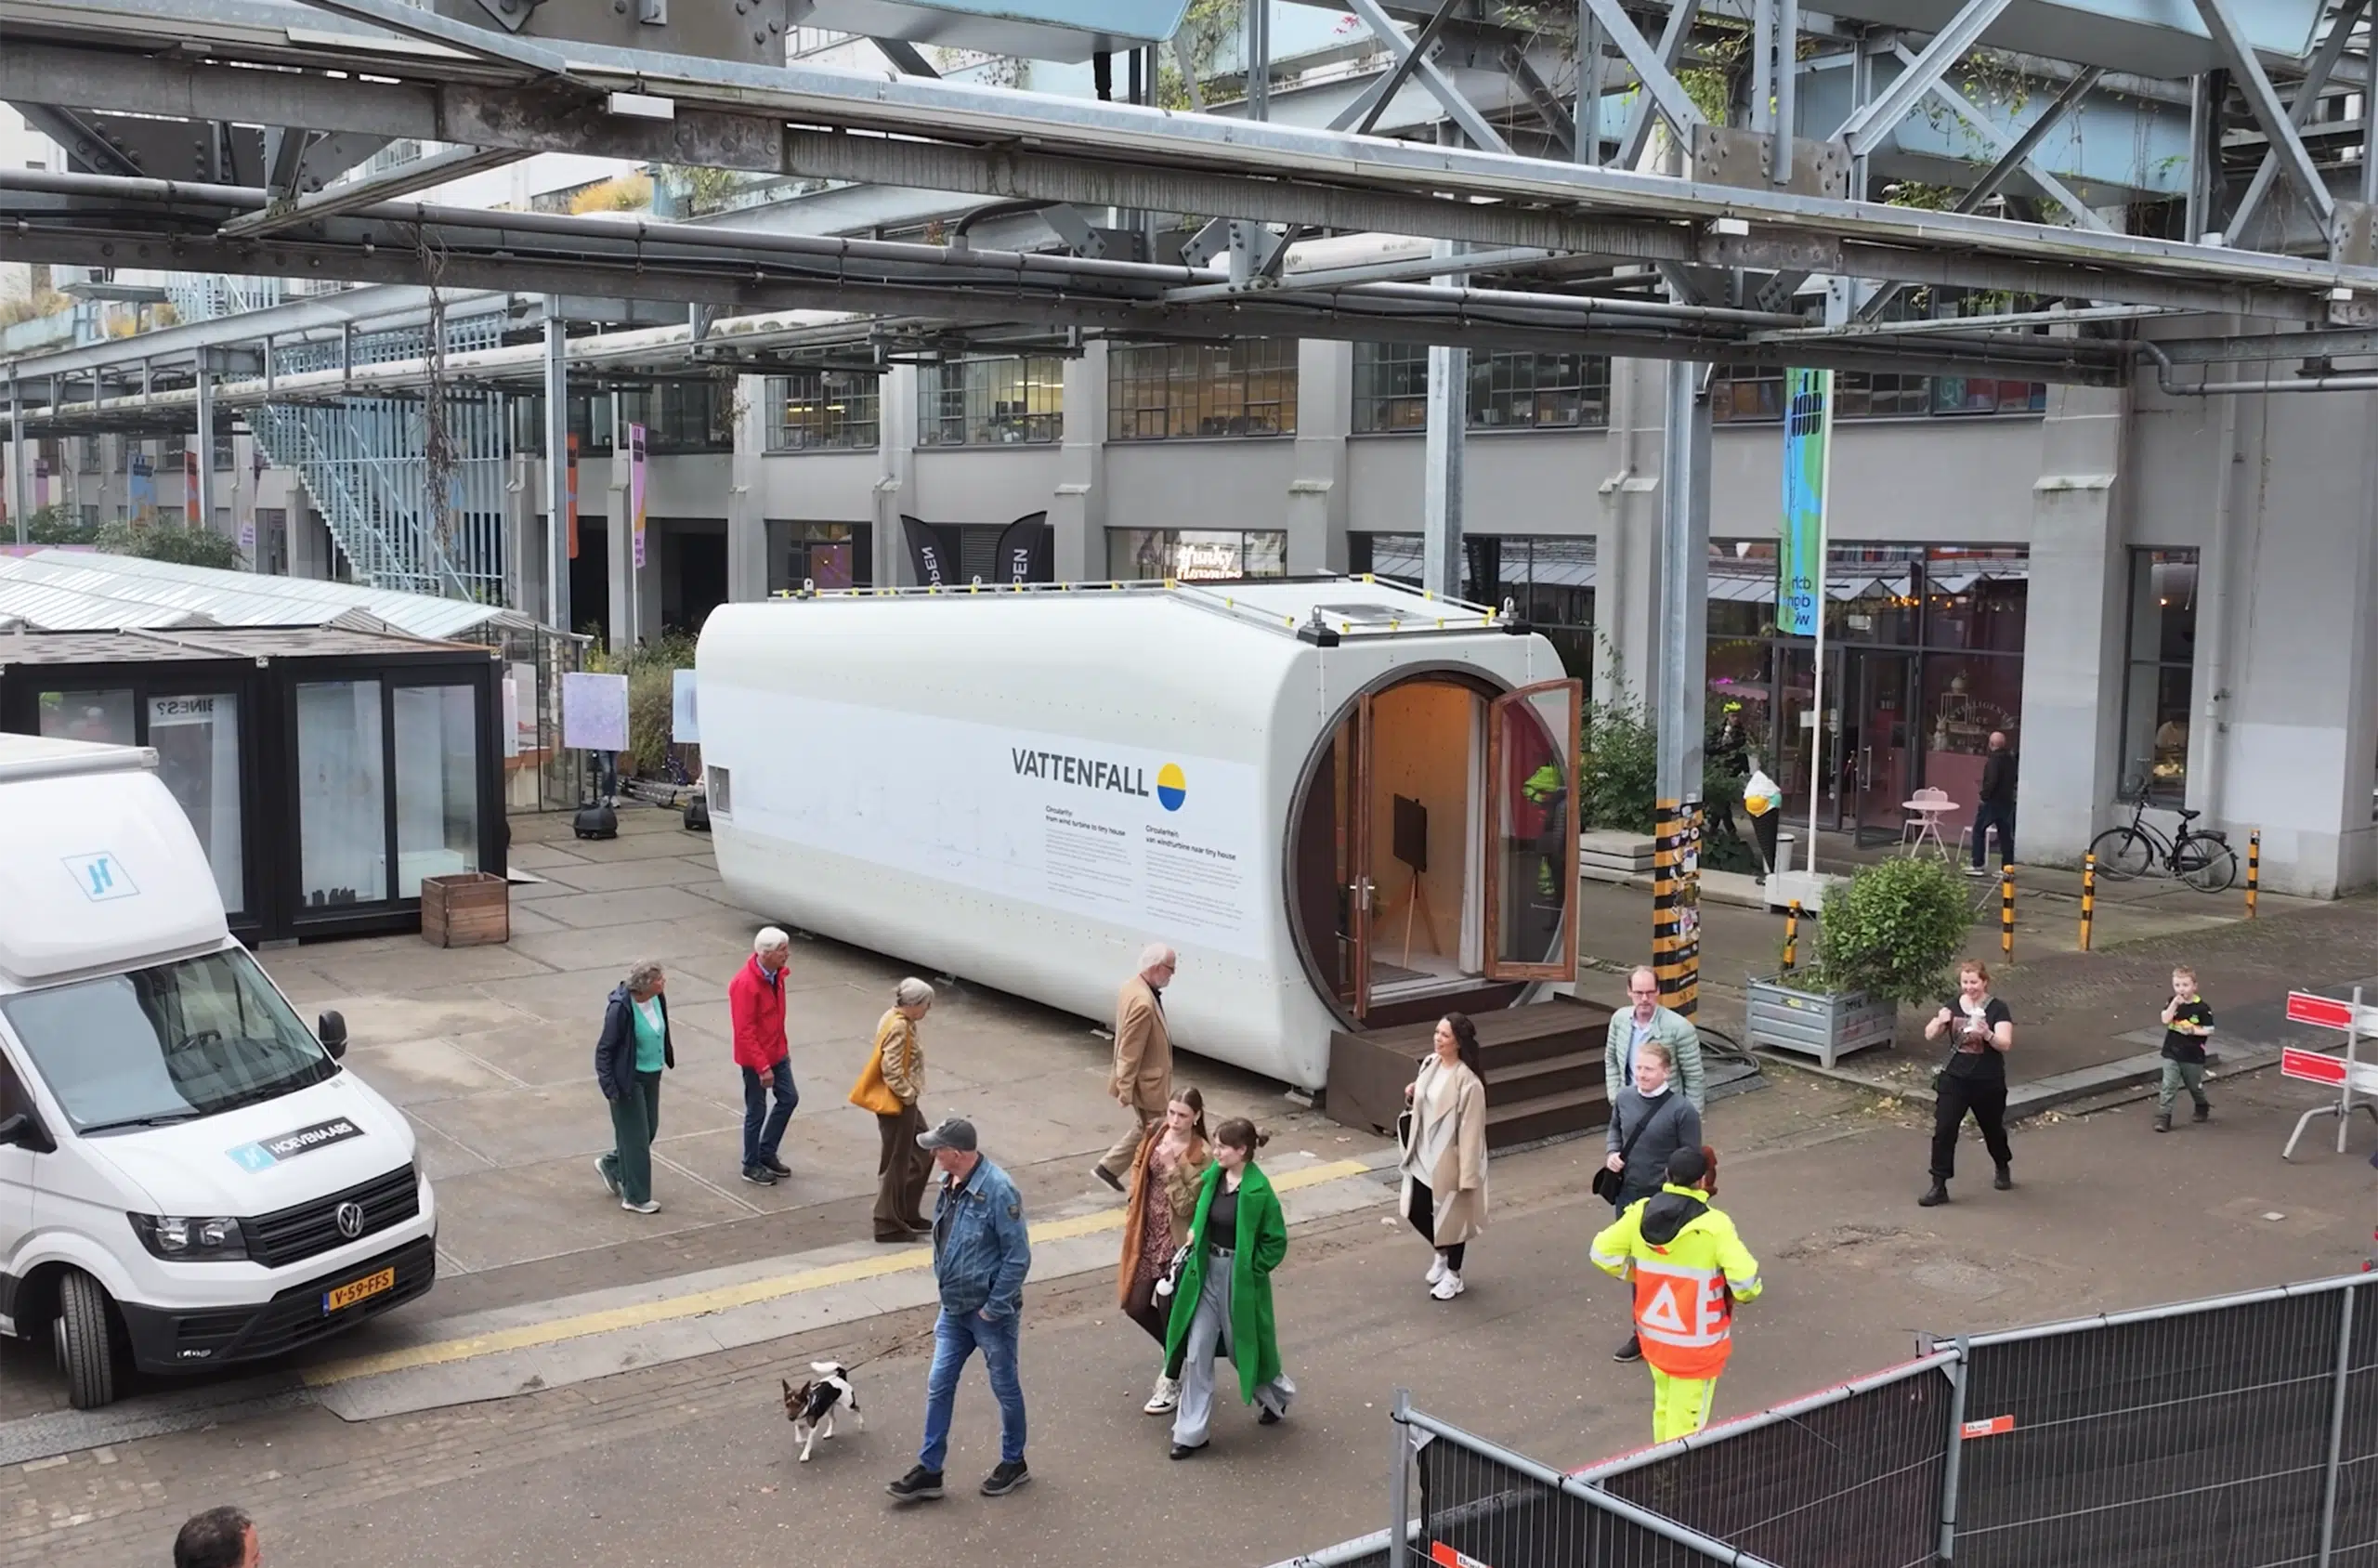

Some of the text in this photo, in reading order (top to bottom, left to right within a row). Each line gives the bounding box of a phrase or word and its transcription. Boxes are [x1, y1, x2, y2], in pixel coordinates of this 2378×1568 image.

[1012, 747, 1150, 798] VATTENFALL
[1108, 827, 1126, 837] house
[1217, 849, 1236, 861] house
[268, 1121, 354, 1155] HOEVENAARS
[334, 1271, 389, 1305] V-59-FFS
